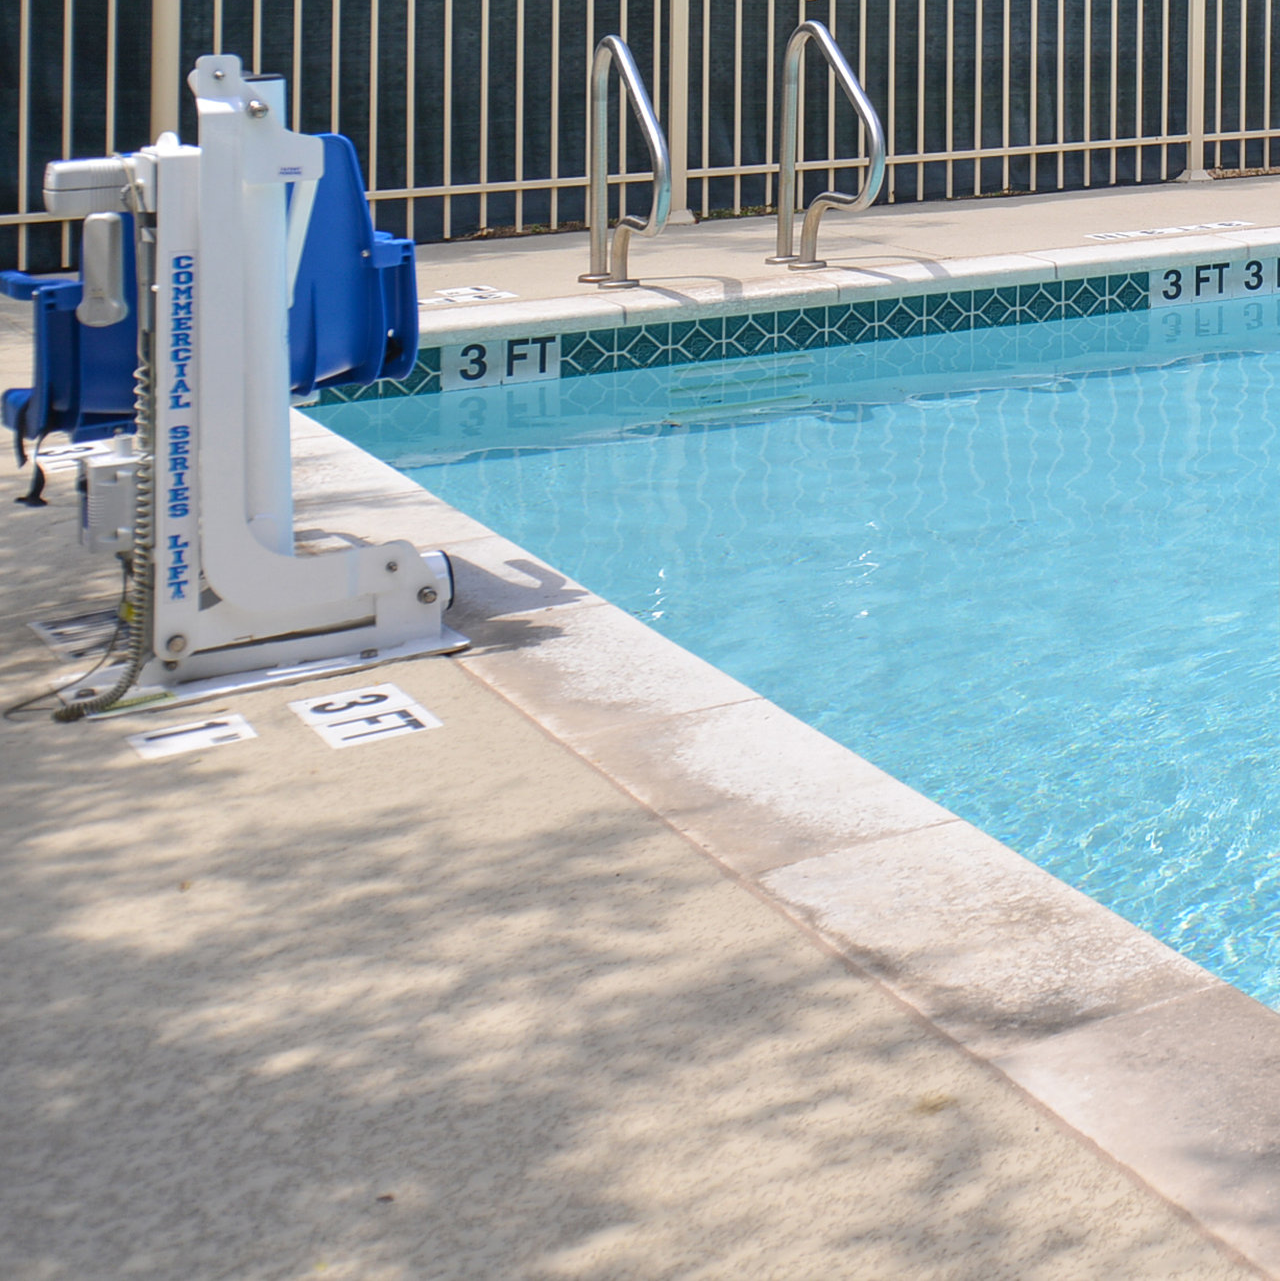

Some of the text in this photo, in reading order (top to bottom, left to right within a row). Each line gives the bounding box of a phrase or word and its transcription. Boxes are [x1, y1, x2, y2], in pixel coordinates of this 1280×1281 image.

[1162, 269, 1182, 300] 3
[1195, 262, 1230, 297] FT
[1244, 260, 1263, 291] 3
[459, 336, 556, 381] 3 FT
[167, 255, 193, 599] COMMERCIAL SERIES LIFT
[309, 693, 427, 741] 3 FT
